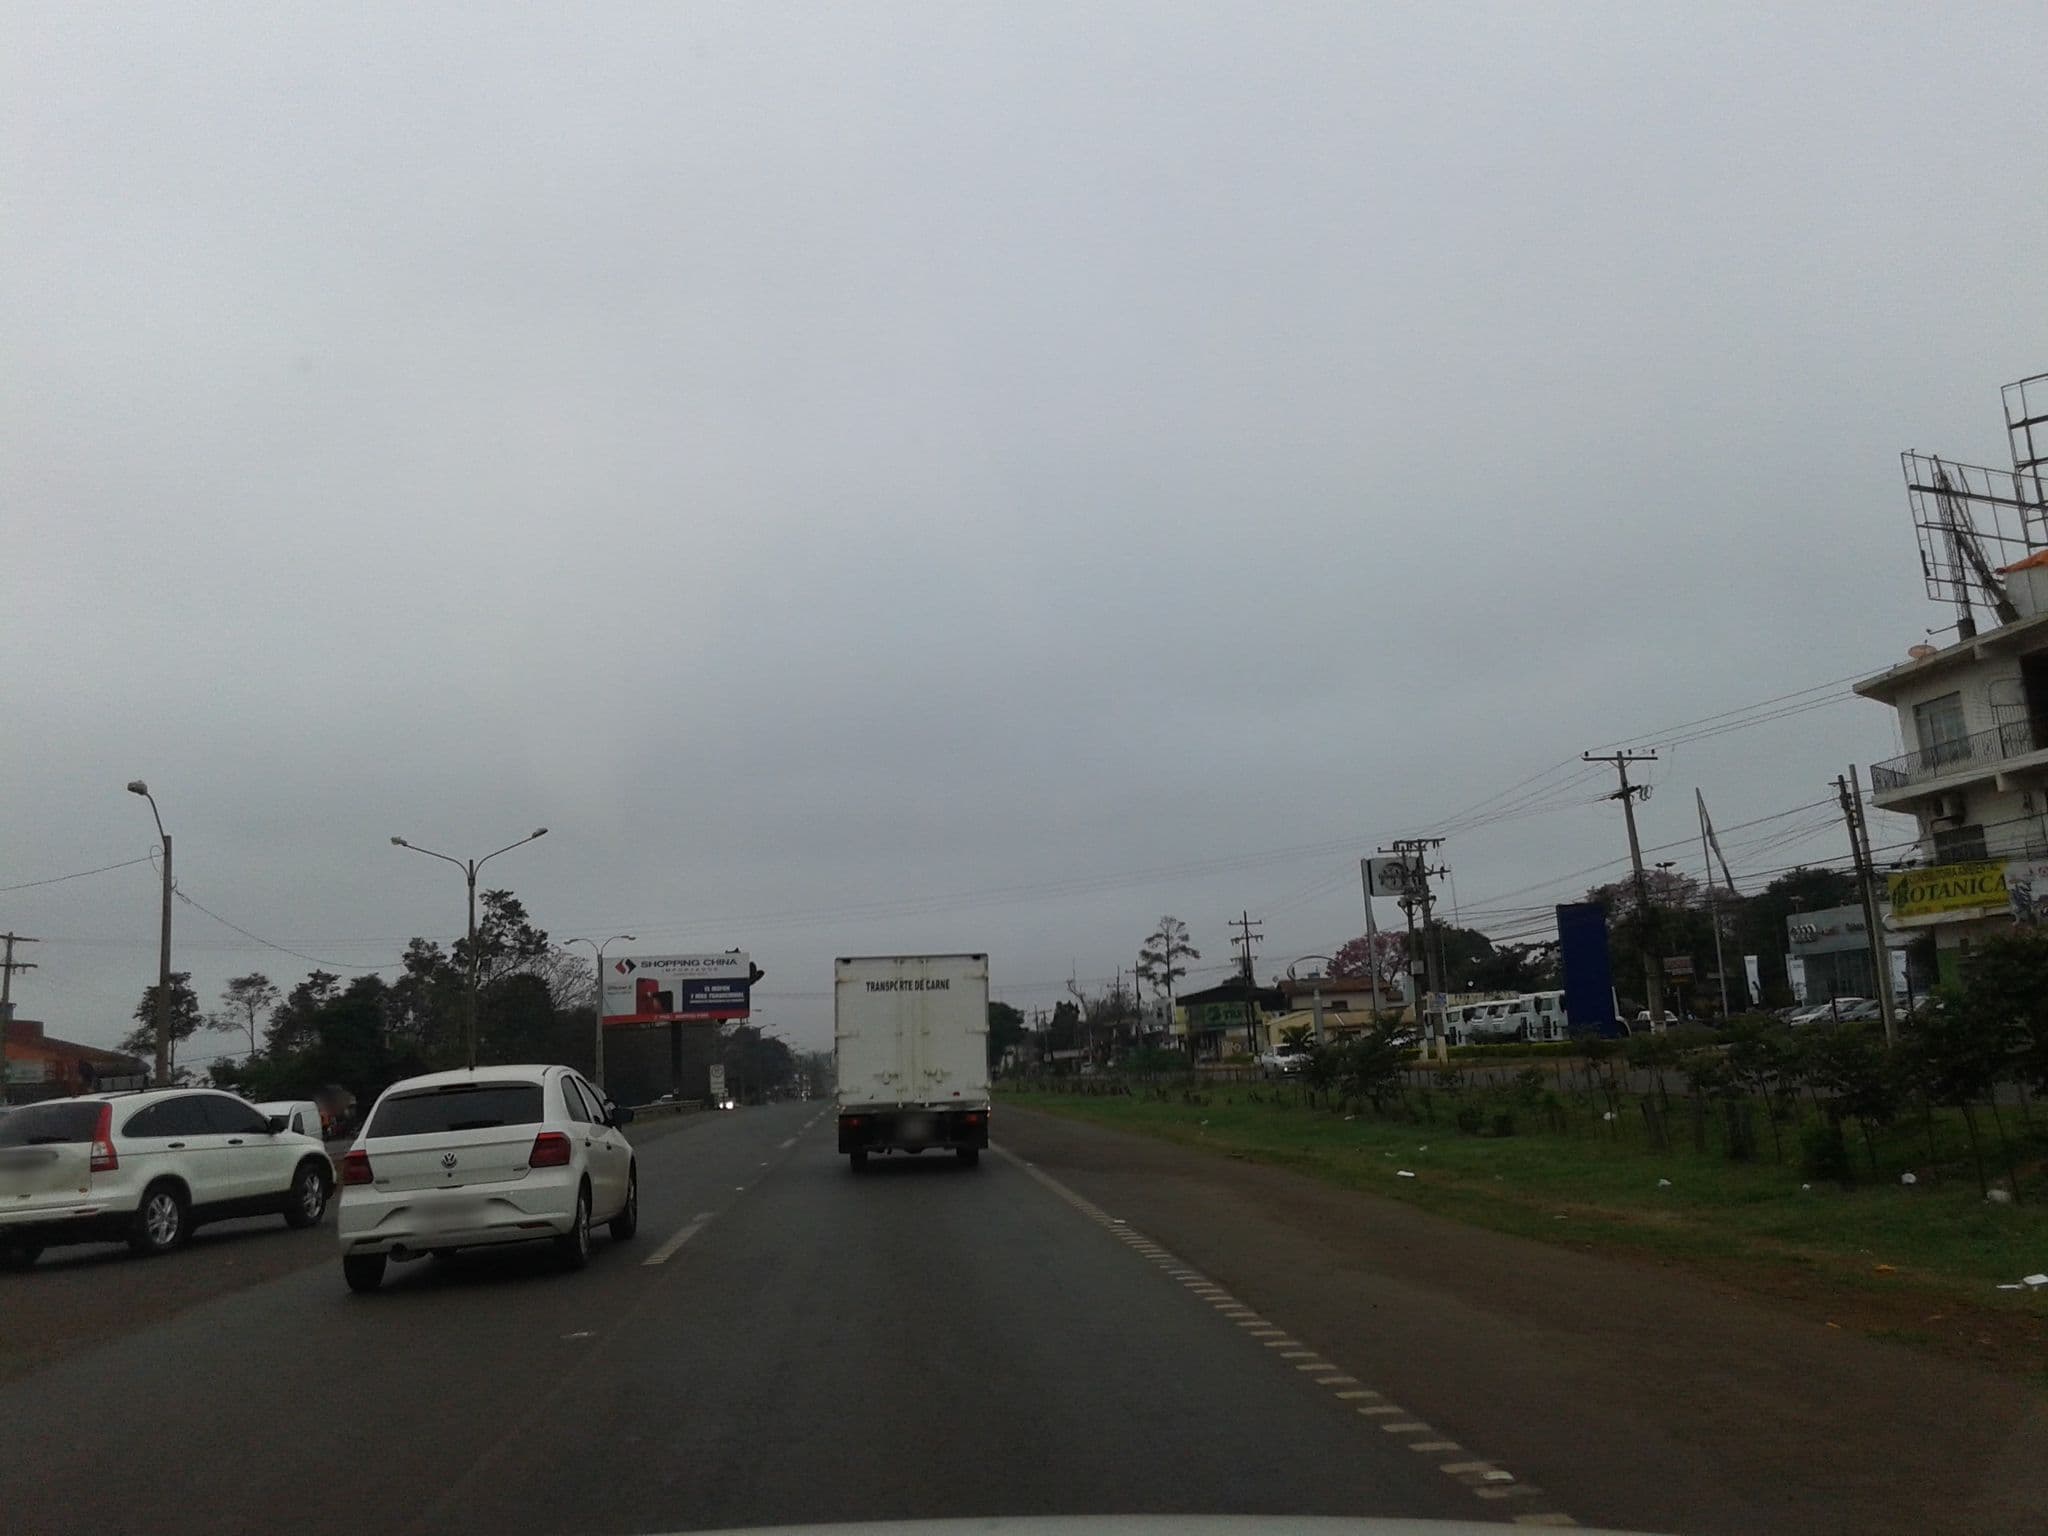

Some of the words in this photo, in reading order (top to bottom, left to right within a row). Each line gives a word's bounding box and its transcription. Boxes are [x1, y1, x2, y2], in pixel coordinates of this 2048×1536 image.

[640, 959, 700, 968] SHOPPING
[703, 958, 738, 967] CHINA
[865, 980, 913, 992] TRANSPORTE
[914, 980, 925, 991] DE
[925, 979, 950, 990] CARNE
